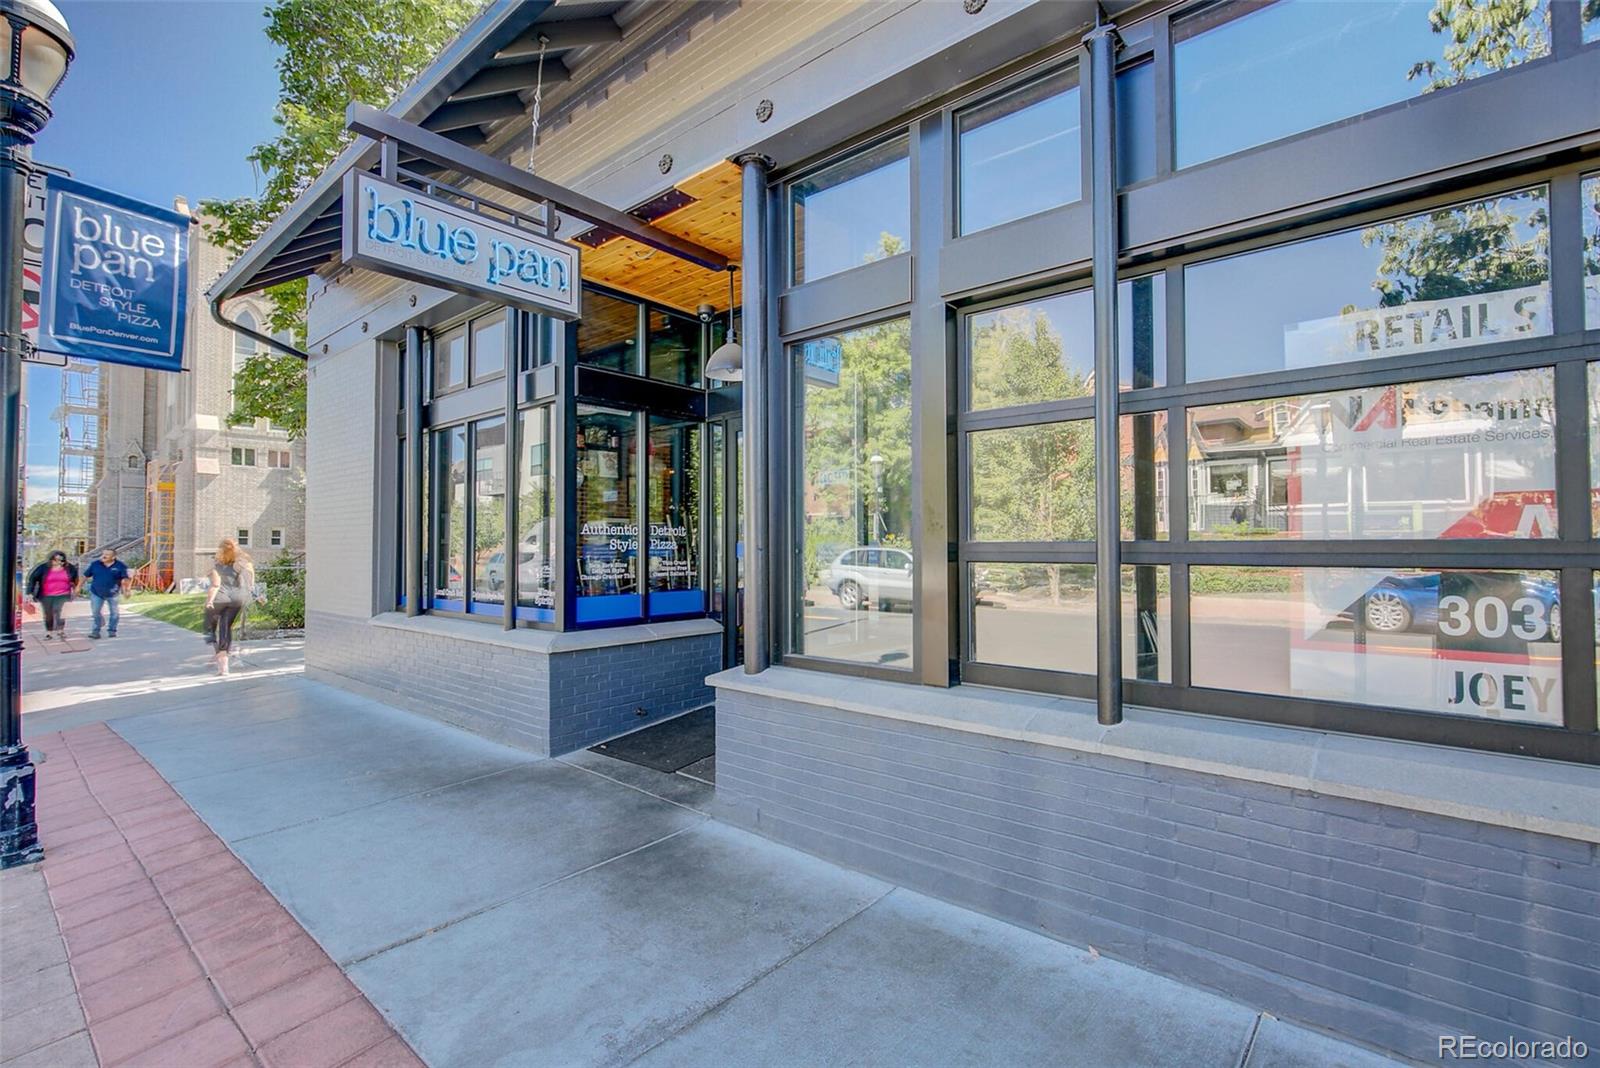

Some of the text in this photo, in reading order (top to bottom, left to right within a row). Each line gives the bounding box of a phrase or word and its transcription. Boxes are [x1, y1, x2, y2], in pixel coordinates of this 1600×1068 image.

[73, 206, 165, 257] blue
[365, 186, 569, 292] blue pan
[71, 242, 155, 282] pan
[70, 278, 136, 298] DETROIT
[99, 295, 146, 314] STYLE
[117, 311, 160, 329] PIZZA
[1354, 303, 1498, 350] RETAIL
[69, 322, 159, 344] BluePanDenver.com
[1402, 437, 1432, 448] Real
[1436, 433, 1480, 446] Estate
[580, 523, 686, 536] Authentic Detroit
[609, 540, 678, 552] Style Pizza
[1438, 595, 1548, 640] 303
[1448, 670, 1557, 714] JOEY
